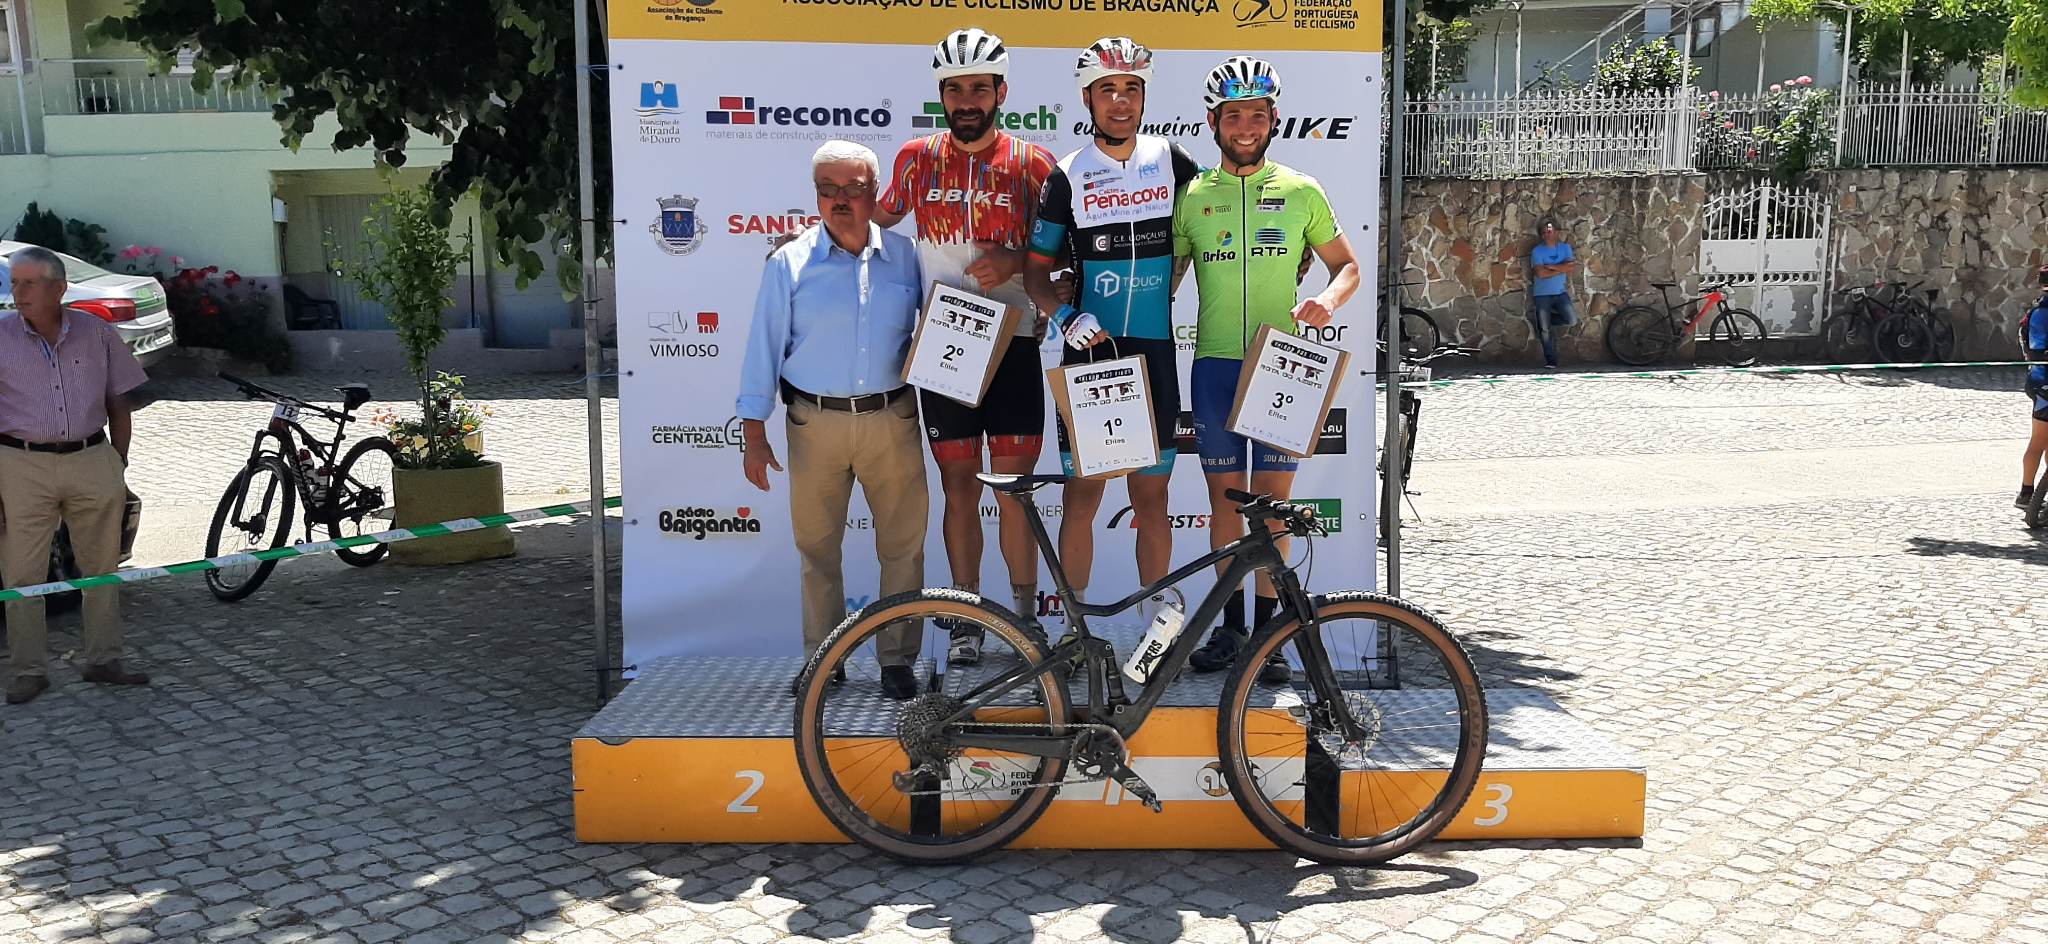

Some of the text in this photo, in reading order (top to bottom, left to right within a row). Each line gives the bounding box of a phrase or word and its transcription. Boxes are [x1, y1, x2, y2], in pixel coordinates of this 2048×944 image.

[963, 0, 1063, 10] CICLISMO
[1070, 0, 1096, 11] DE
[1103, 0, 1219, 16] BRAGANÇA
[1294, 9, 1359, 19] PORTUGUESA
[1294, 20, 1355, 29] DE CICLISMO
[758, 106, 891, 127] reconco
[996, 105, 1057, 130] tech
[640, 126, 680, 135] Miranda
[706, 129, 752, 140] materiais
[757, 129, 768, 139] de
[770, 130, 827, 142] construção
[651, 135, 680, 144] Douro
[926, 188, 1012, 207] BBIKE
[1083, 185, 1169, 212] Penacova
[1203, 249, 1236, 262] Brisa
[1251, 247, 1288, 257] RTP
[650, 344, 719, 357] VIMIOSO
[652, 425, 697, 433] FARMÁCIA
[652, 433, 724, 444] CENTRAL
[727, 769, 765, 813] 2
[1473, 783, 1513, 826] 3
